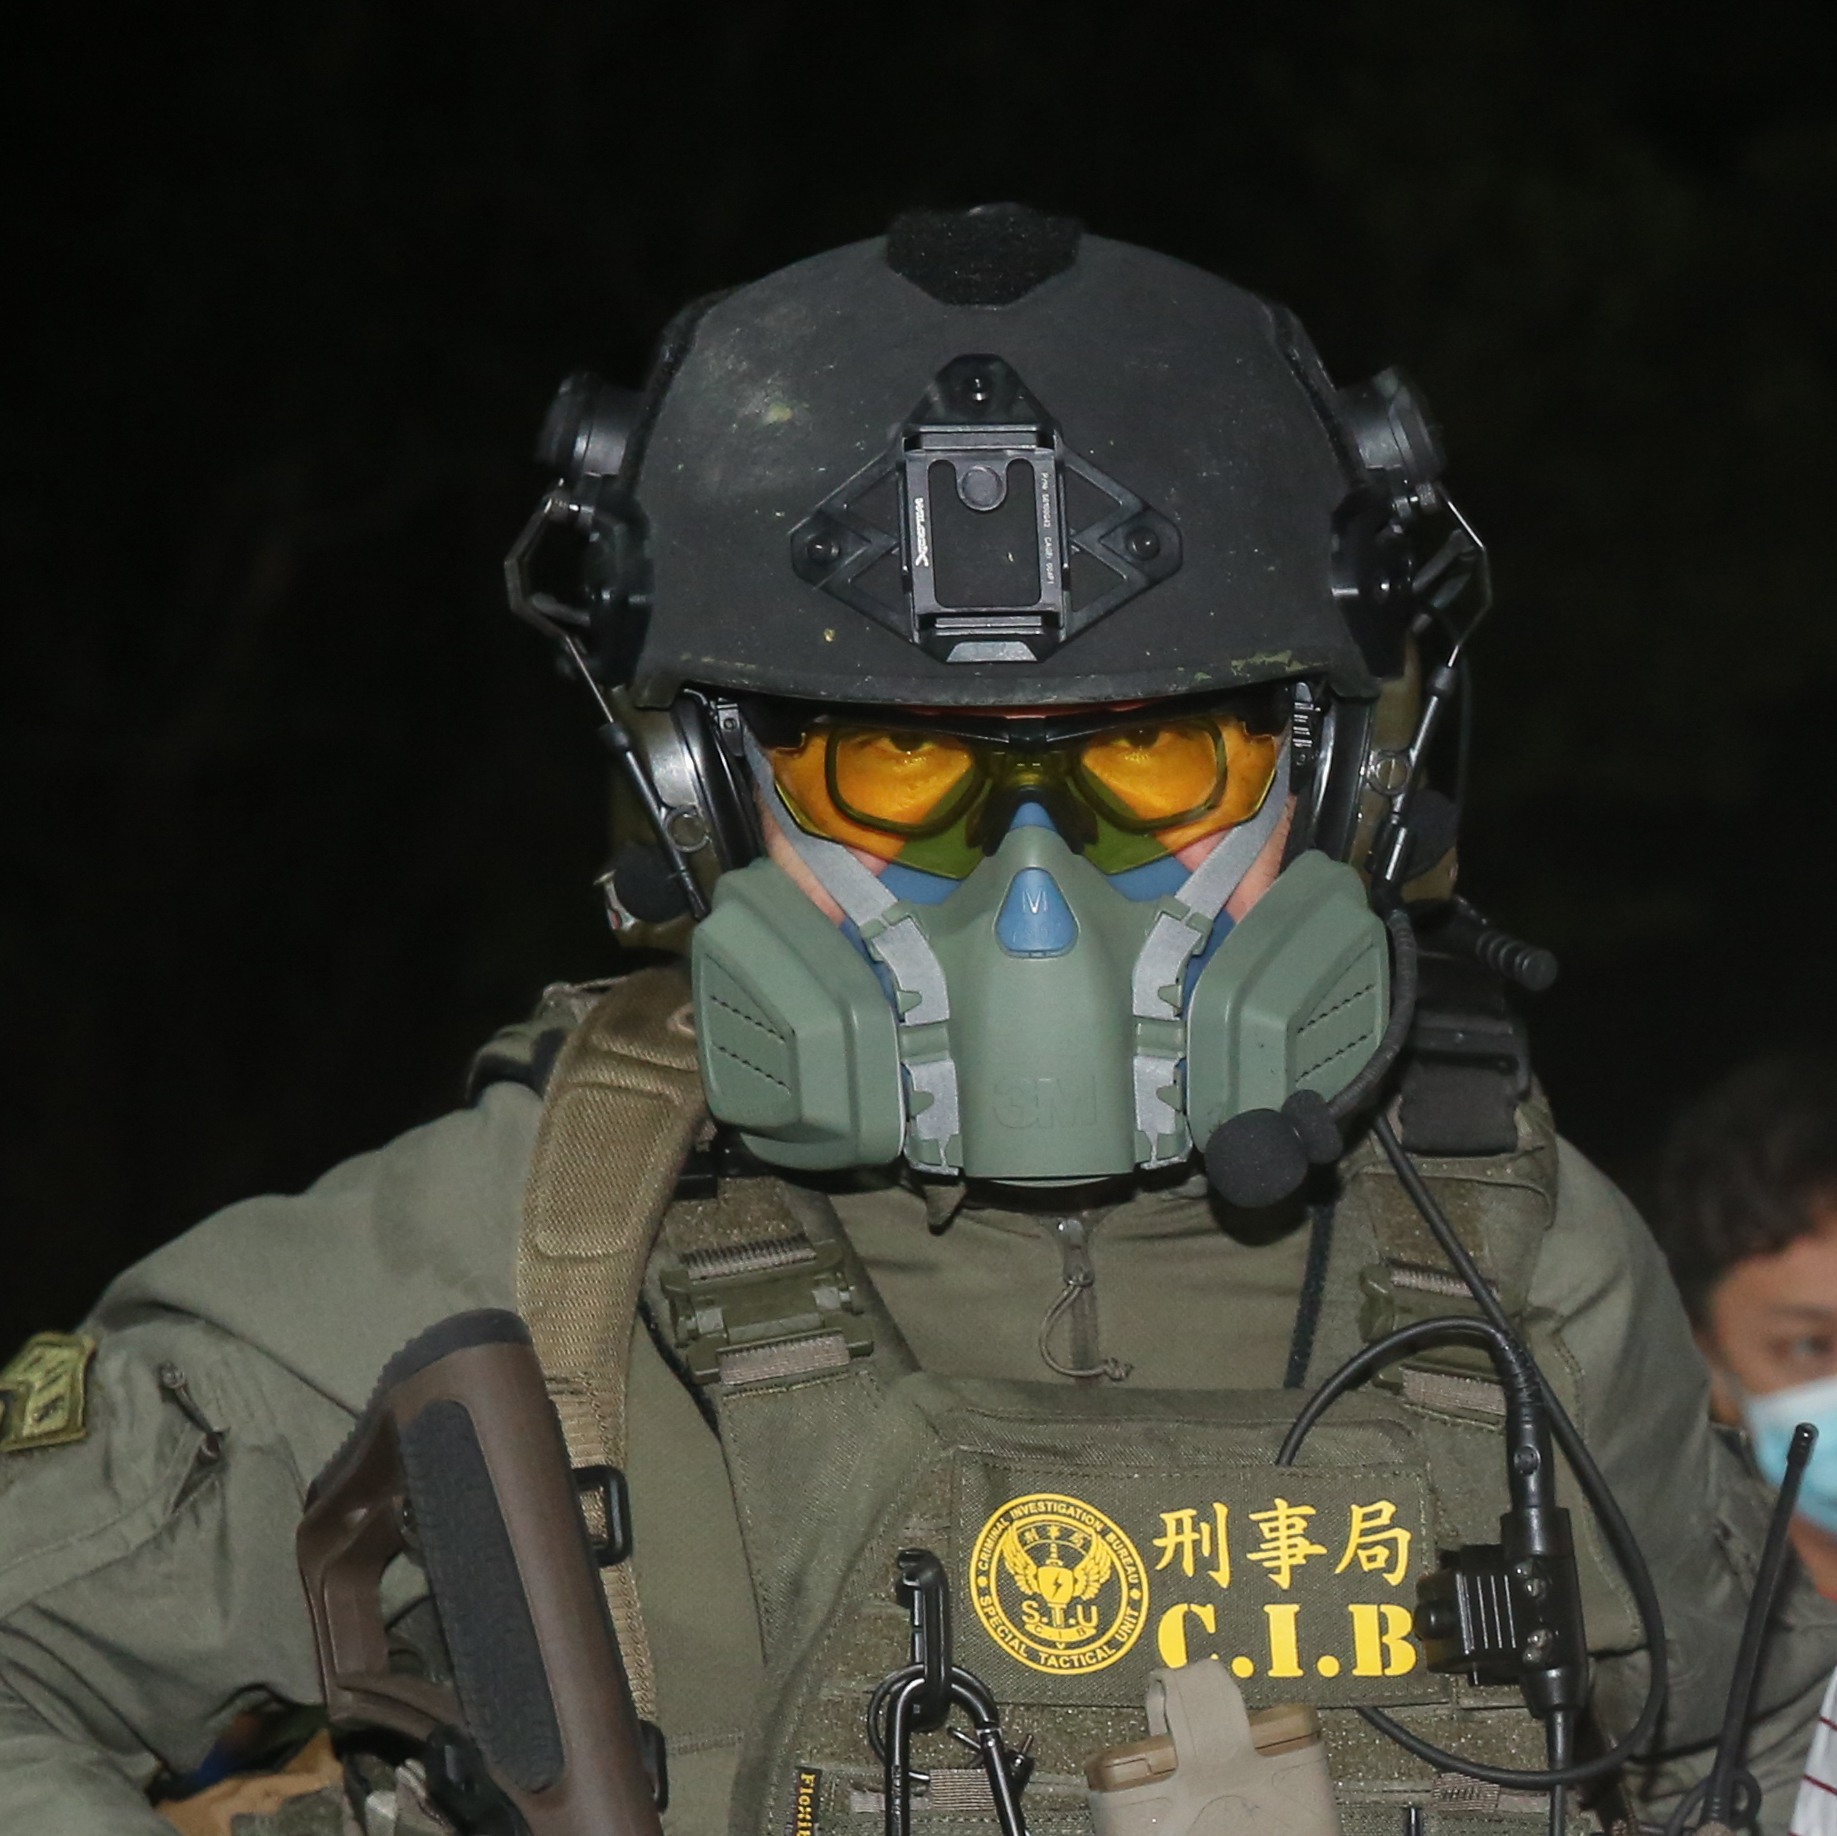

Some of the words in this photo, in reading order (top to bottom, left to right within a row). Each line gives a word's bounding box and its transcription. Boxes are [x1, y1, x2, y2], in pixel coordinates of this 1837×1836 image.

[914, 497, 929, 567] WILCOX
[978, 1517, 1010, 1571] CRIMINAL
[1010, 1501, 1105, 1532] INVESTIGATION
[1104, 1532, 1140, 1585] BUREAU
[1152, 1497, 1412, 1590] 刑事局
[979, 1595, 1029, 1658] SPECIAL
[1038, 1644, 1117, 1668] TACTICAL
[1114, 1606, 1140, 1643] UNIT
